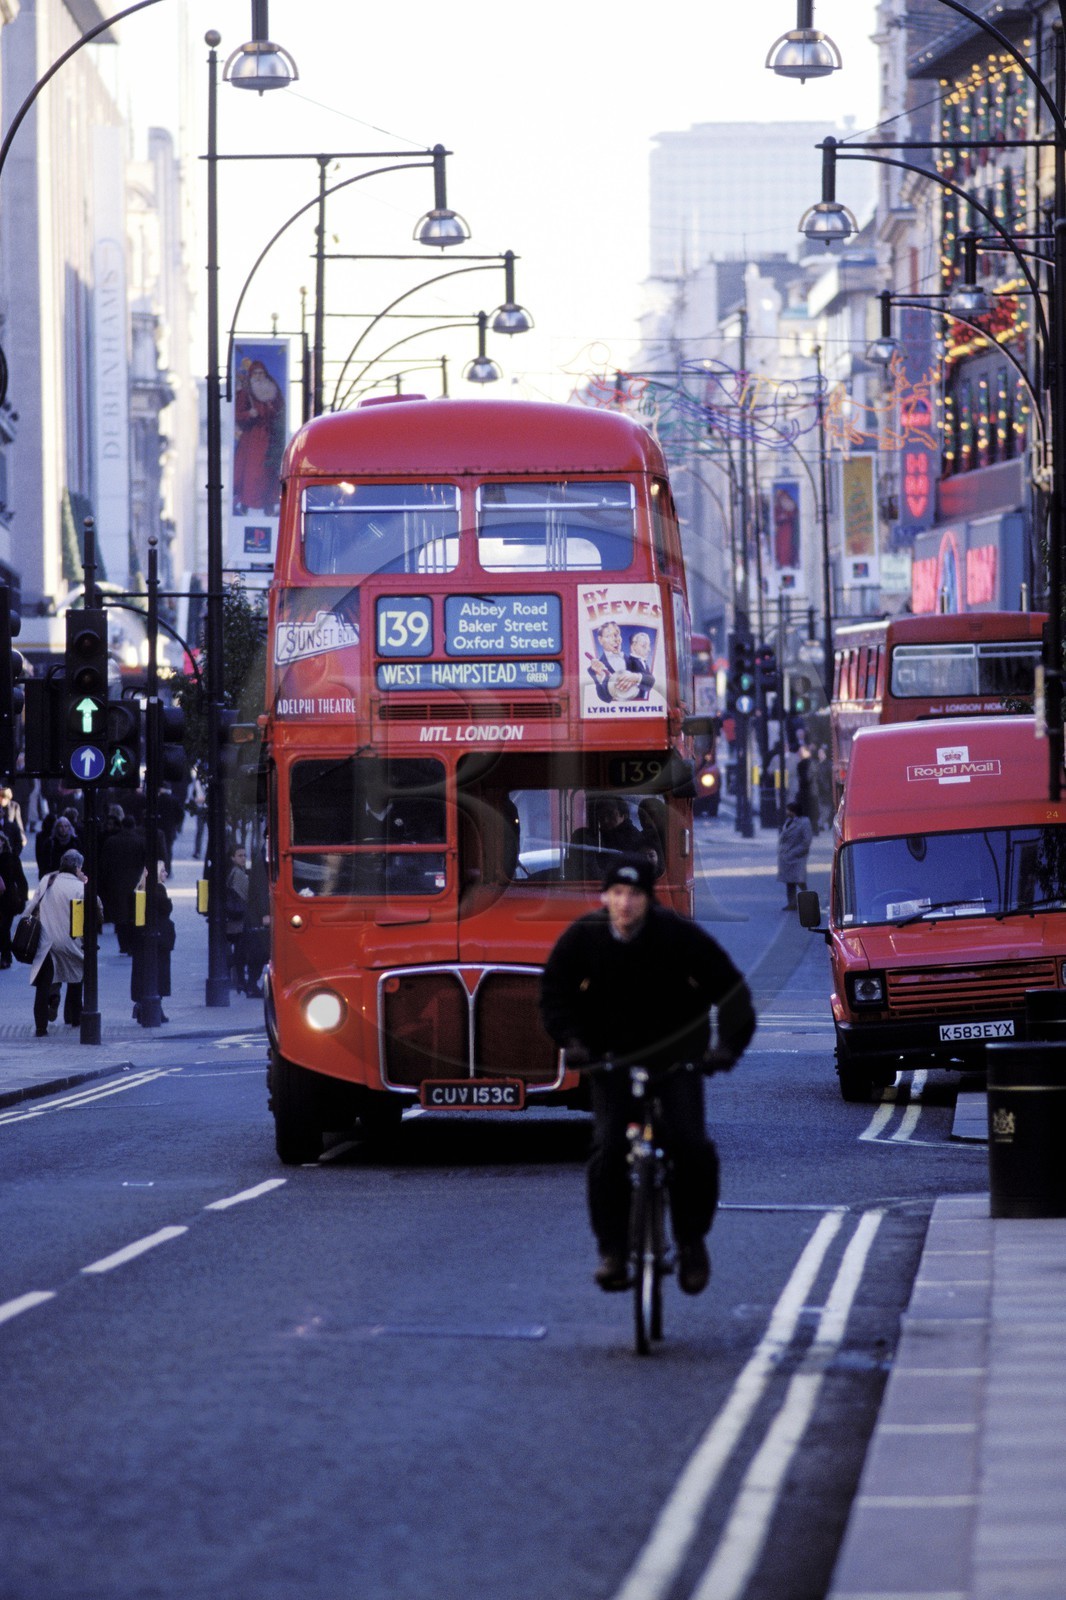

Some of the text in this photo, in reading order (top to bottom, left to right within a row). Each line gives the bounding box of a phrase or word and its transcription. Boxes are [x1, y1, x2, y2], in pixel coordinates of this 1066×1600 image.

[101, 269, 122, 459] DEBENHAMS
[905, 452, 930, 518] HMV
[583, 588, 608, 603] BY
[460, 602, 548, 618] Abbey Road
[586, 600, 662, 621] JEEVES
[379, 611, 429, 646] 139
[458, 619, 549, 633] Baker Street
[286, 628, 335, 657] SUNSET
[453, 636, 555, 649] Oxford Street
[382, 663, 517, 684] WEST HAMPSTEAD
[520, 662, 555, 673] WEST END
[526, 672, 548, 682] GREEN
[277, 698, 357, 714] ADELPHI THEATRE
[945, 703, 981, 713] LONDON
[420, 725, 524, 742] MTL LONDON
[622, 761, 662, 783] 139
[914, 762, 994, 778] Royal Mail
[1046, 811, 1059, 819] 24
[941, 1023, 1012, 1040] K583EYX
